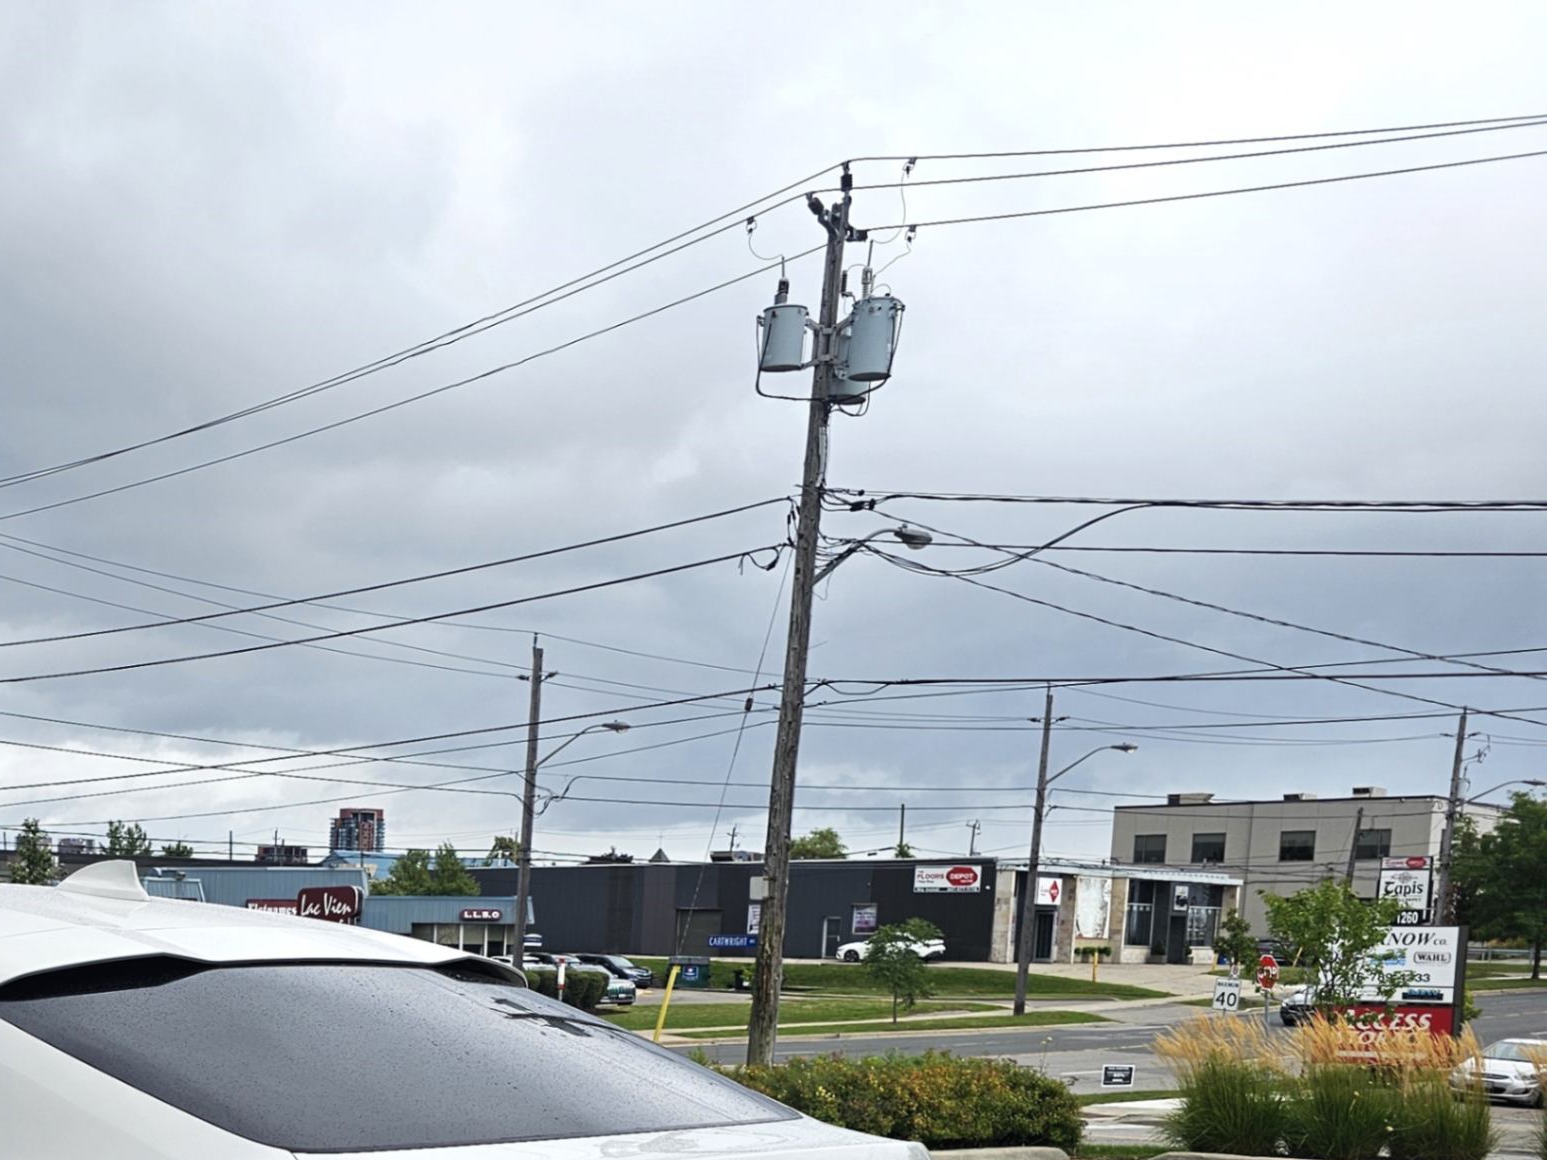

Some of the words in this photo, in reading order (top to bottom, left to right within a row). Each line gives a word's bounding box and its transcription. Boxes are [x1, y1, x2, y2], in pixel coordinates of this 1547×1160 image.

[1384, 881, 1424, 897] Tapis
[300, 894, 321, 916] Lac
[323, 892, 352, 916] Vien
[1396, 911, 1419, 924] 1260
[708, 936, 748, 946] CARTWRIGHT
[1417, 953, 1447, 962] WAHL
[1215, 991, 1237, 1007] 40
